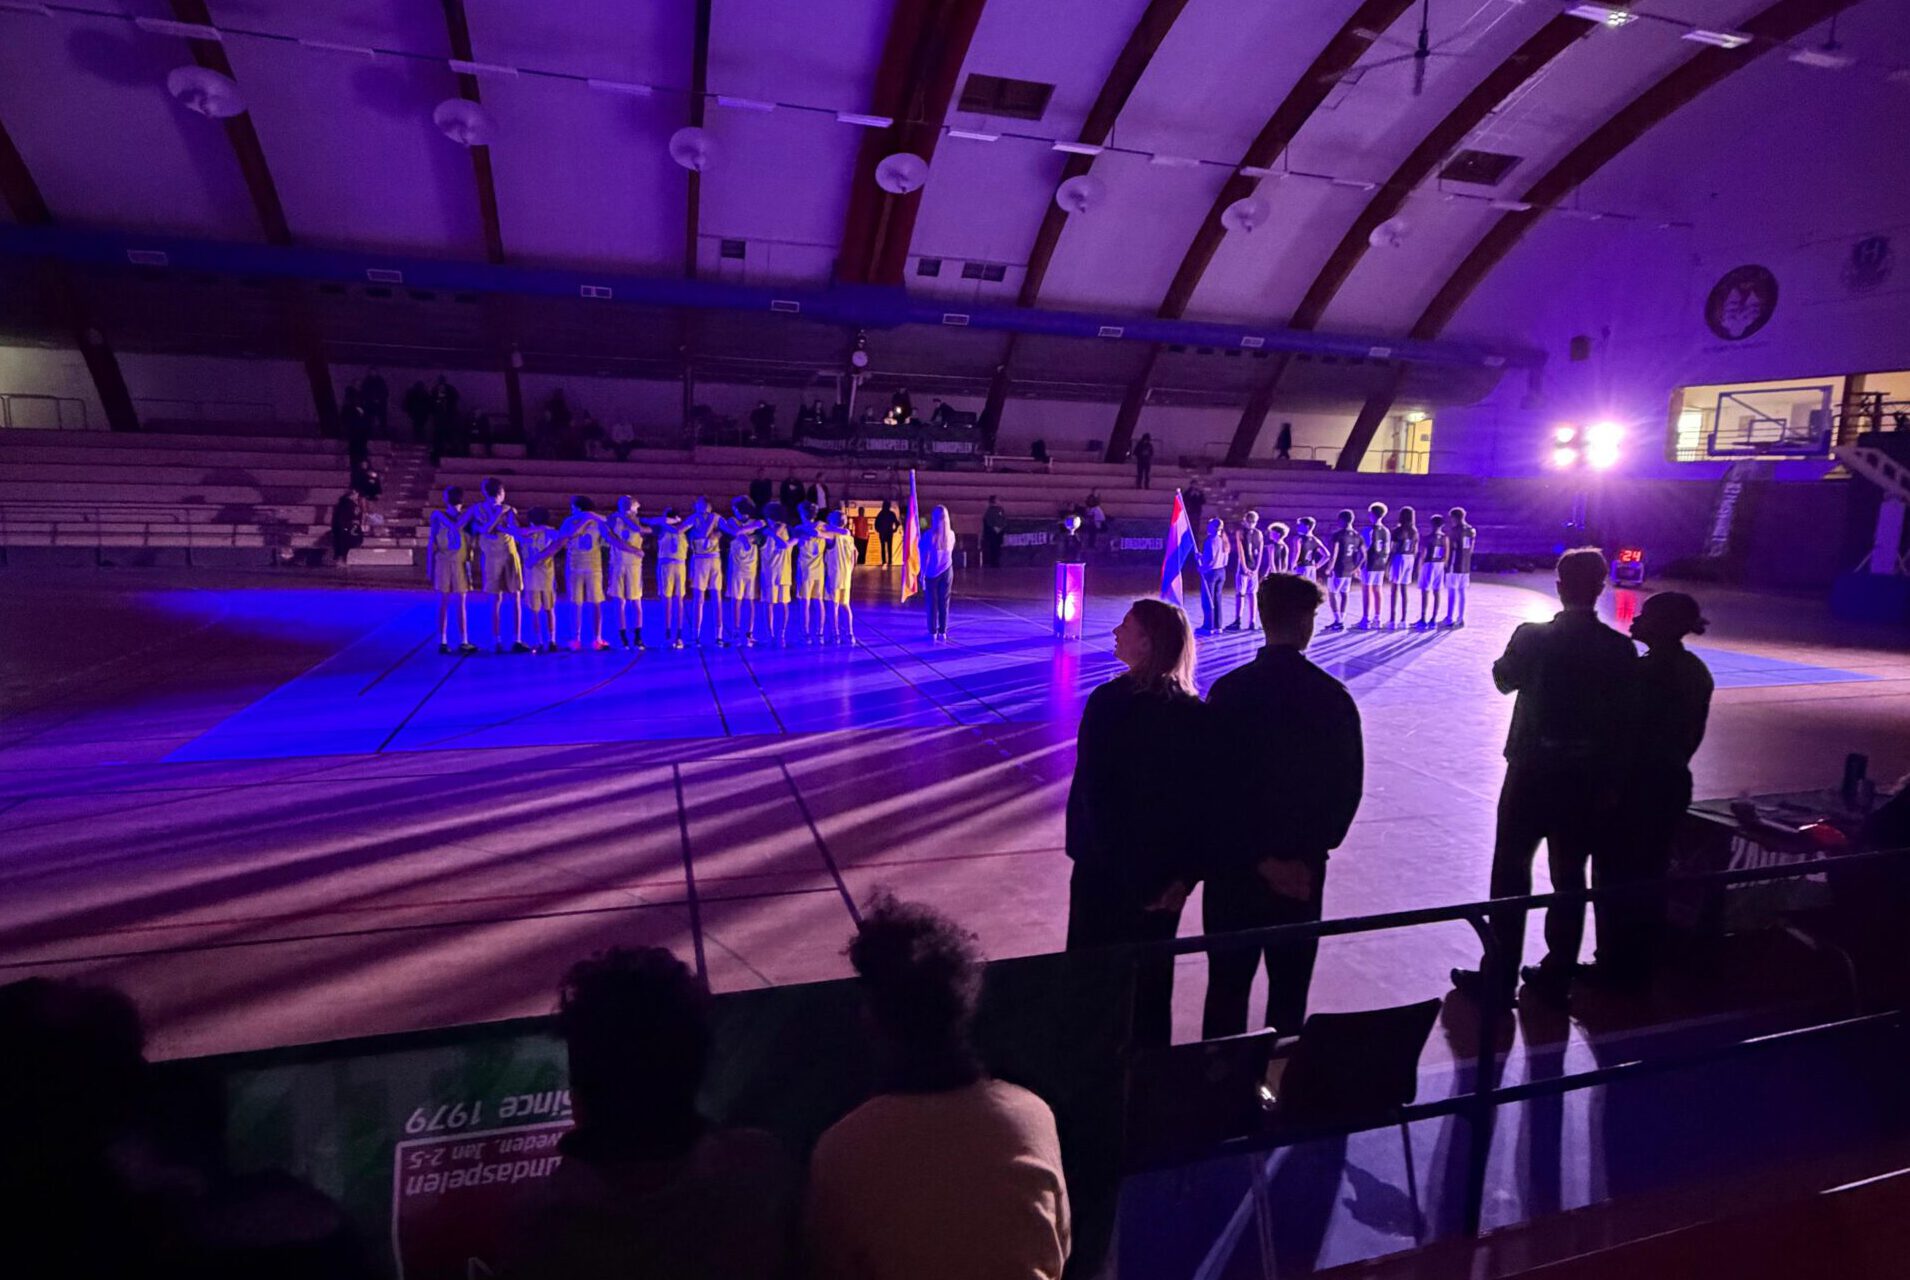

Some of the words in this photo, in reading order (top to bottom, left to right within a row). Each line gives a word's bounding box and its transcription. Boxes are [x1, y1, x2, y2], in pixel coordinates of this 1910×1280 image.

[1622, 549, 1642, 562] 24
[405, 1100, 483, 1134] 1979
[408, 1147, 446, 1170] 2-5
[451, 1142, 487, 1160] Jan
[405, 1155, 563, 1197] undaspelen
